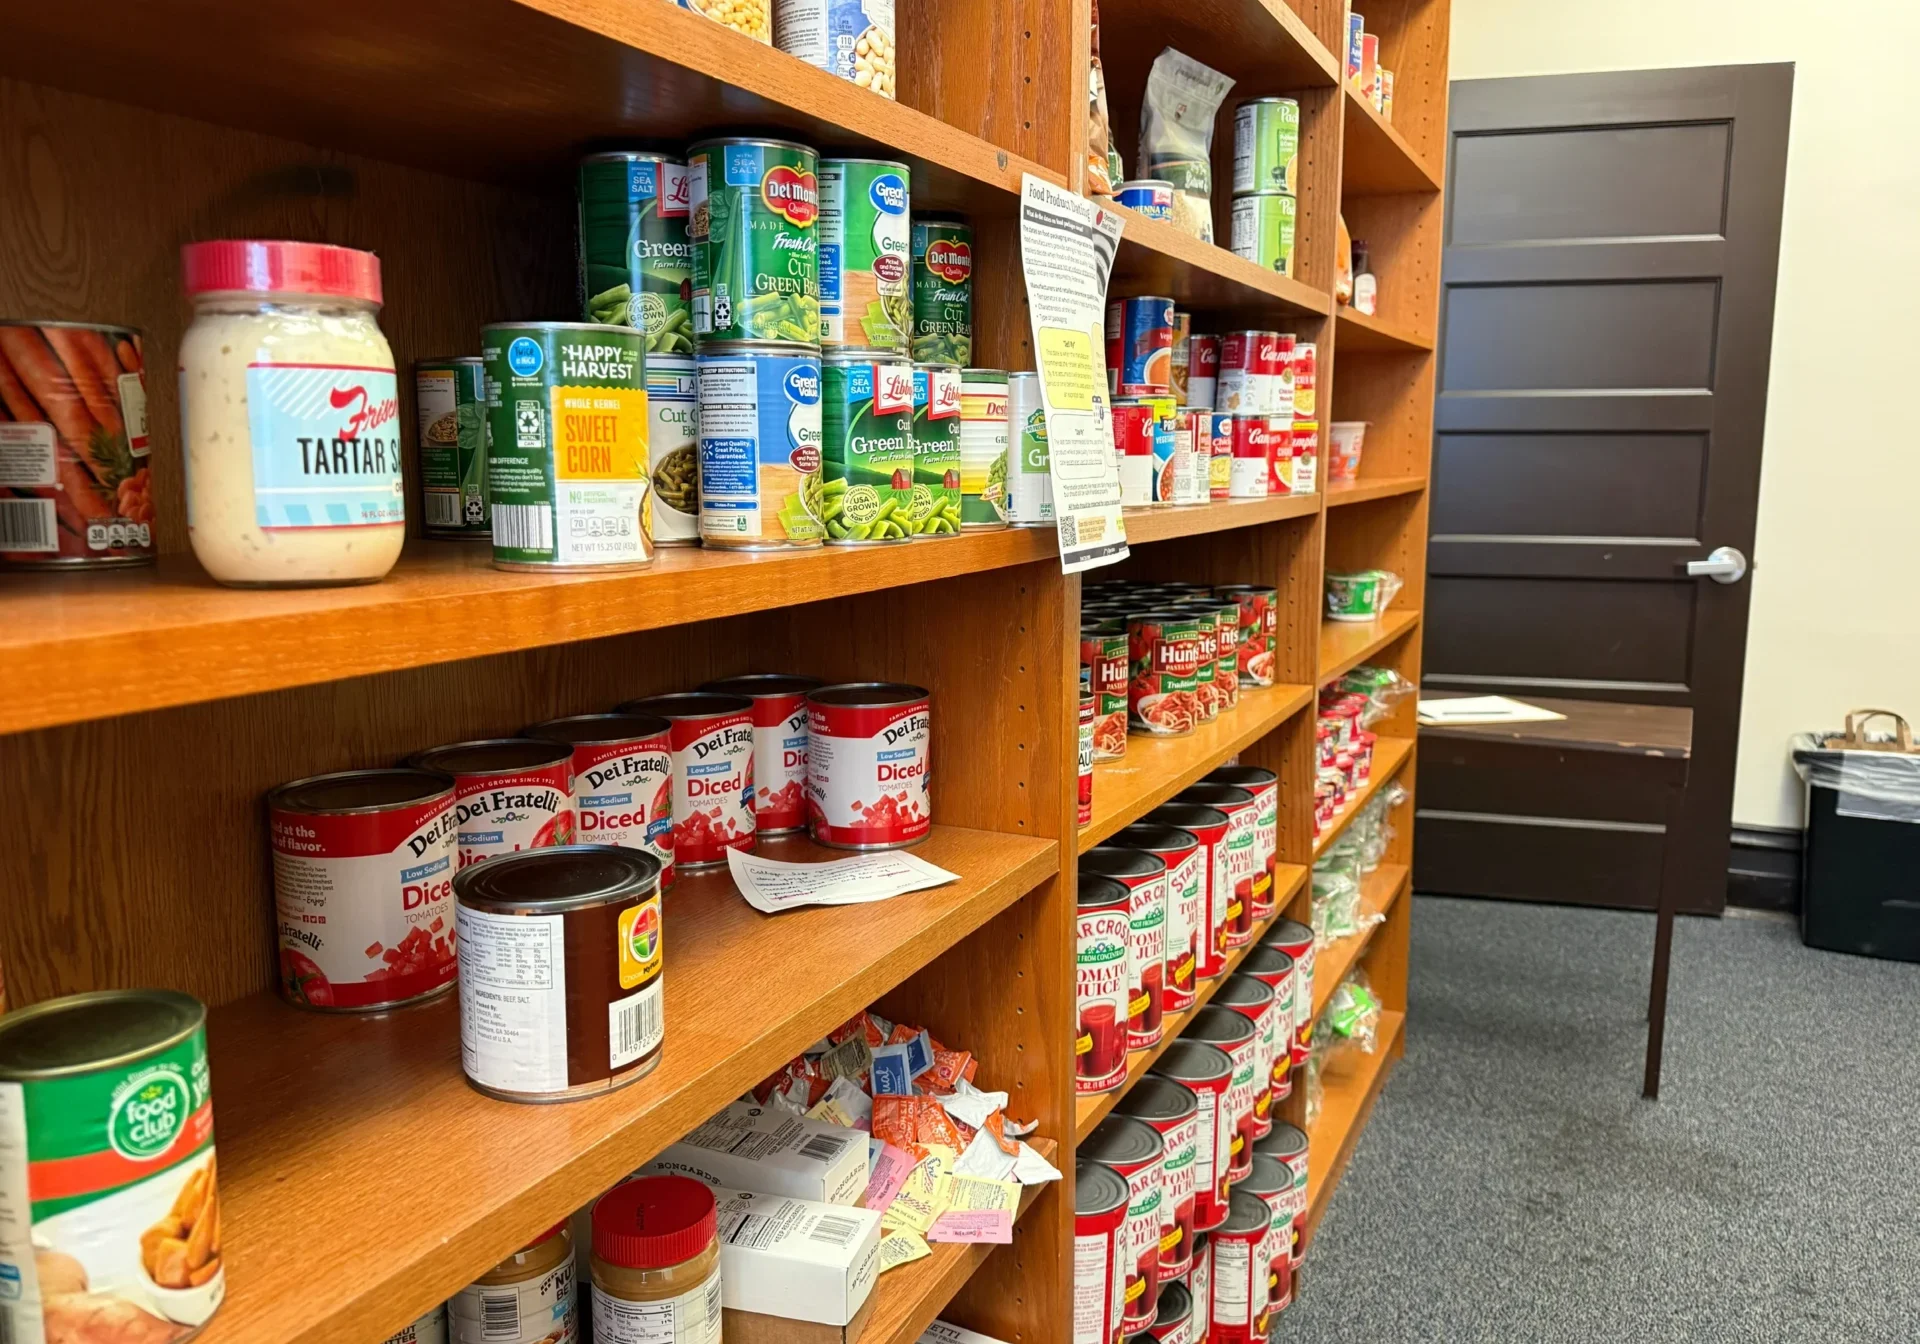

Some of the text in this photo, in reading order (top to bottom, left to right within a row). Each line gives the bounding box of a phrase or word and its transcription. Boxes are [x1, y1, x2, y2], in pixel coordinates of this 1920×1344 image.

[732, 166, 758, 174] SALT
[633, 176, 652, 184] SEA
[631, 185, 654, 193] SALT
[768, 181, 790, 199] Del
[875, 182, 904, 199] Great
[883, 197, 905, 208] Value
[1029, 183, 1045, 202] Food
[1046, 190, 1072, 211] Product
[788, 202, 810, 216] Quality
[750, 221, 784, 231] MADE
[772, 232, 801, 251] Fresh
[931, 251, 945, 264] Del
[787, 258, 811, 279] CUT
[945, 267, 963, 277] Quality
[755, 273, 800, 293] GREEN
[916, 281, 942, 289] MADE
[933, 289, 957, 302] Fresh
[637, 304, 654, 312] USA
[944, 307, 965, 321] CUT
[630, 310, 665, 321] GROWN
[920, 320, 954, 334] GREEN
[567, 345, 622, 362] HAPPY
[562, 361, 633, 379] HARVEST
[790, 374, 818, 388] Great
[798, 385, 819, 398] Value
[850, 386, 871, 394] SALT
[564, 398, 621, 409] WHOLE KERNEL
[659, 408, 686, 422] Cut
[565, 414, 618, 443] SWEET
[897, 419, 911, 431] Cut
[851, 434, 905, 455] Green
[297, 437, 386, 475] TARTAR
[567, 445, 612, 474] CORN
[869, 454, 905, 464] Farm Fresh
[923, 456, 941, 465] Farm
[846, 502, 878, 512] GROWN
[574, 519, 583, 527] 70
[850, 510, 877, 522] NON GMO
[91, 529, 104, 538] 30
[585, 543, 595, 551] WT
[597, 543, 613, 551] 15.25
[1166, 663, 1184, 671] PASTA
[889, 705, 923, 722] FAMILY GROWN
[700, 717, 739, 734] FAMILY GROWN
[883, 725, 910, 746] Dei
[693, 737, 723, 759] Dei
[786, 740, 798, 748] Low
[593, 750, 617, 763] FAMILY
[619, 745, 643, 753] GROWN
[880, 750, 914, 760] Low Sodium
[585, 755, 669, 790] Dei Fratelli
[690, 764, 729, 774] Low Sodium
[877, 756, 923, 782] Diced
[458, 783, 485, 796] FAMILY
[487, 778, 517, 787] GROWN
[687, 771, 742, 797] Diced
[878, 781, 913, 792] TOMATOES
[583, 794, 629, 805] Low Sodium
[688, 796, 728, 808] TOMATOES
[456, 790, 560, 827] Dei Fratelli
[415, 808, 438, 826] FAMILY
[580, 804, 645, 831] Diced
[283, 825, 316, 838] at the
[464, 833, 499, 842] Sodium
[581, 831, 628, 842] TOMATOES
[287, 838, 326, 852] flavor.
[407, 822, 441, 858] Dei
[406, 859, 448, 880] Low Sodium
[404, 902, 448, 925] TOMATOES
[1077, 978, 1120, 997] JUICE
[475, 989, 502, 1001] INGREDIENTS:
[503, 995, 516, 1003] BEEF,
[476, 1001, 489, 1009] Packed
[477, 1030, 492, 1040] Product
[612, 1040, 651, 1061] 0 19722
[126, 1086, 176, 1124] food
[129, 1108, 176, 1143] club
[767, 1143, 778, 1156] KEEP
[778, 1122, 804, 1146] REFRIGERATED
[657, 1162, 720, 1185] BONGARDS
[829, 1161, 867, 1204] BONGARDS
[774, 1203, 806, 1243] KEEP REFRIGERATED
[851, 1241, 880, 1291] BONGARDS
[614, 1335, 631, 1343] Protein
